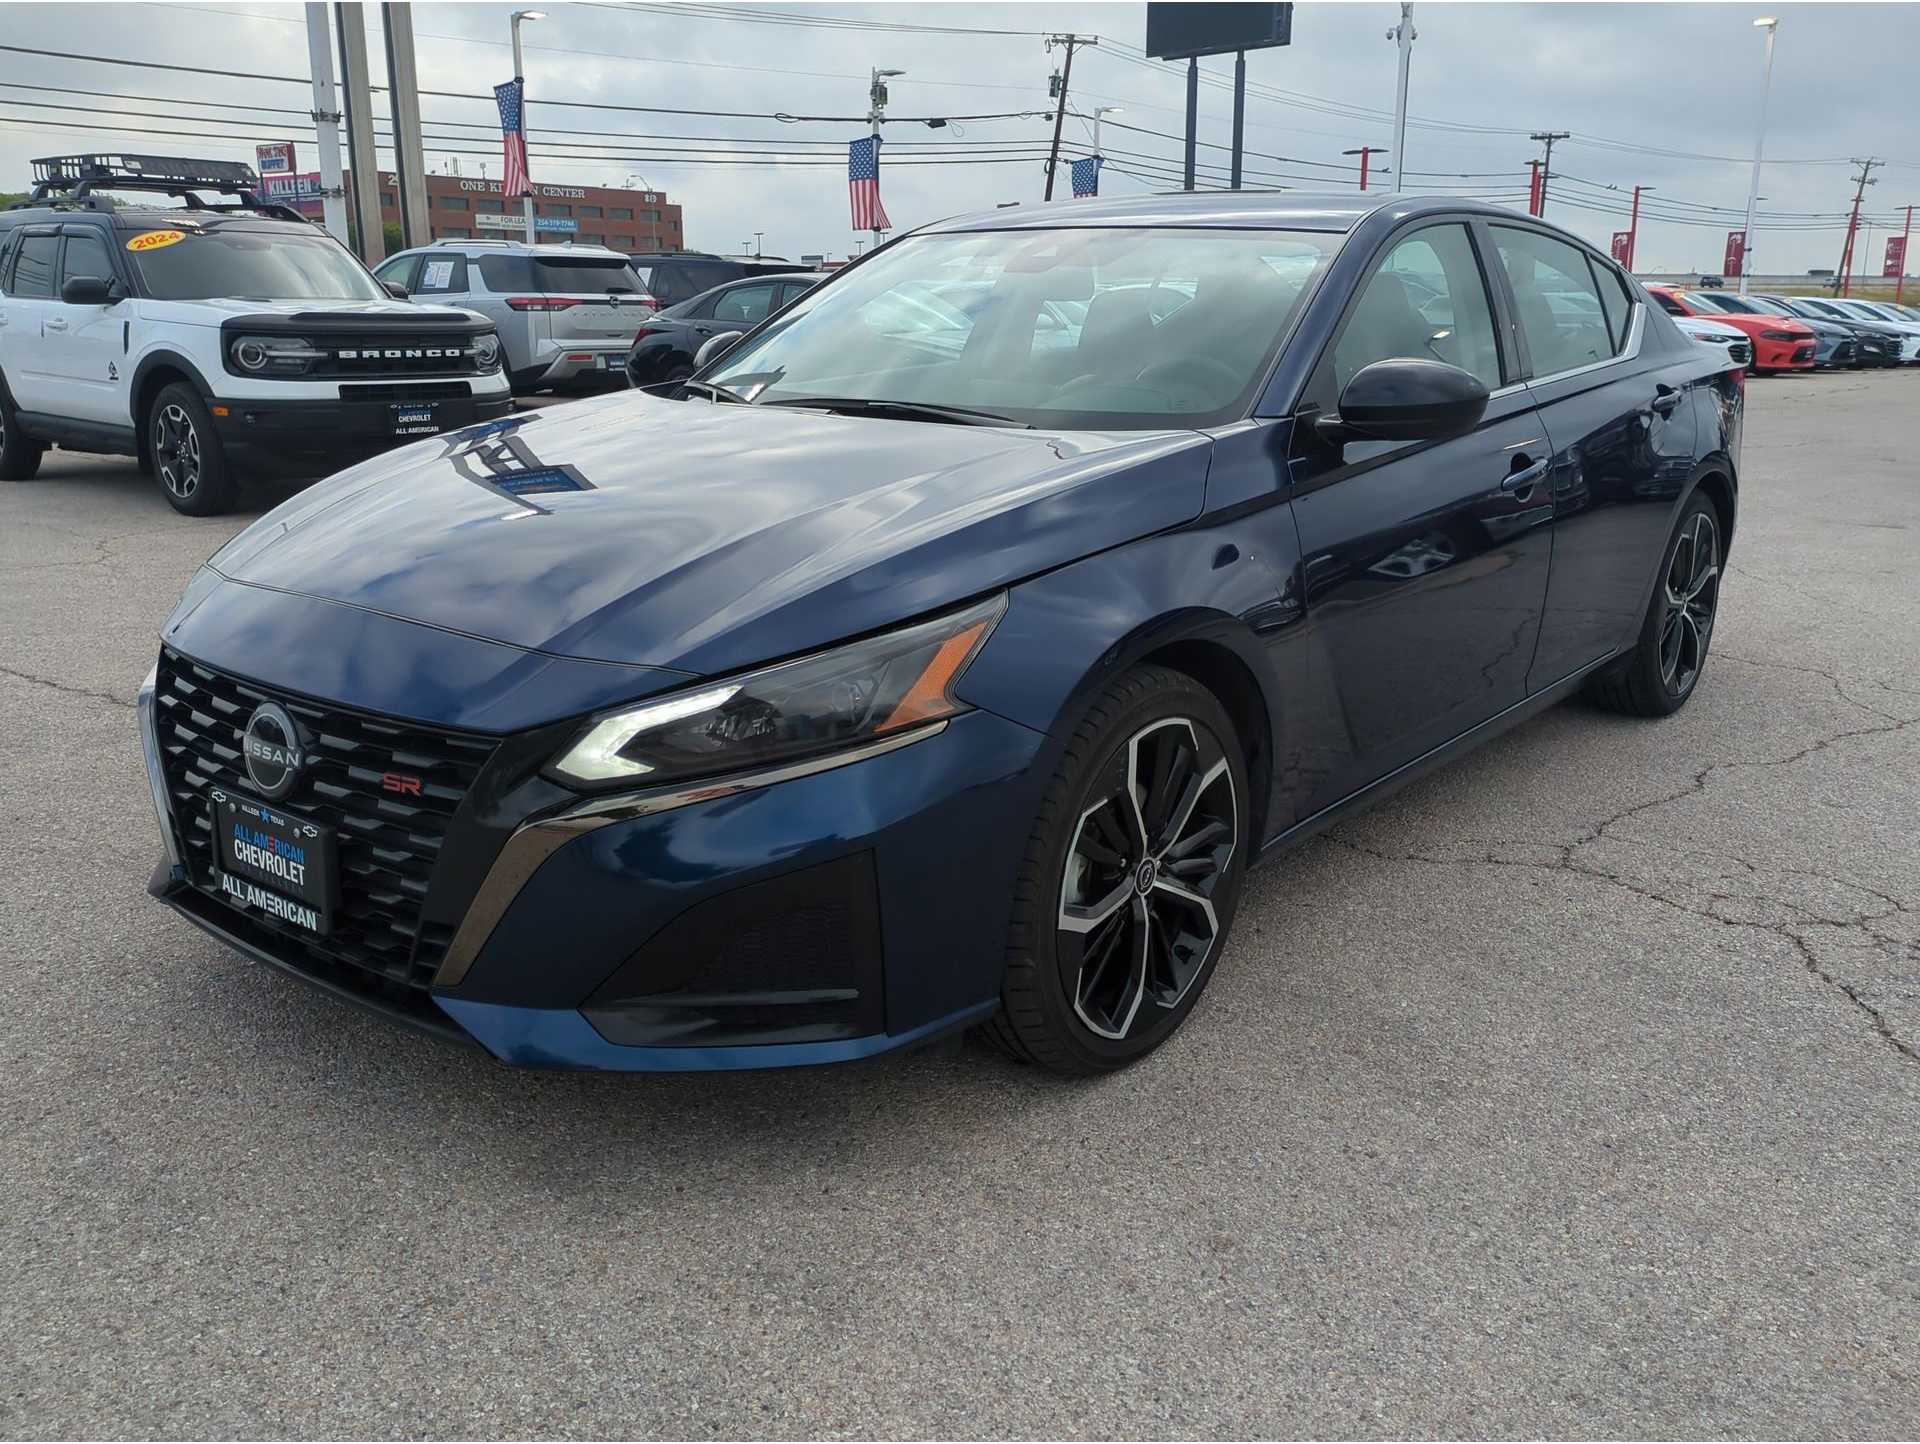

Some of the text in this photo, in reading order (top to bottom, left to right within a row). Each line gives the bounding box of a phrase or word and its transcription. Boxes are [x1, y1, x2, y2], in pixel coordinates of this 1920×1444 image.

[460, 180, 485, 192] ONE
[543, 186, 585, 198] CENTER
[134, 231, 180, 249] 2024
[339, 349, 460, 359] BRONCO
[398, 414, 431, 423] CHEVROLET
[408, 425, 439, 433] AMERICAN
[244, 737, 299, 767] NISSAN
[384, 772, 421, 796] SR
[233, 823, 304, 864] ALL AMERICAN
[234, 839, 305, 886] CHEVROLET
[222, 874, 245, 900] ALL
[247, 884, 317, 931] AMERICAN
